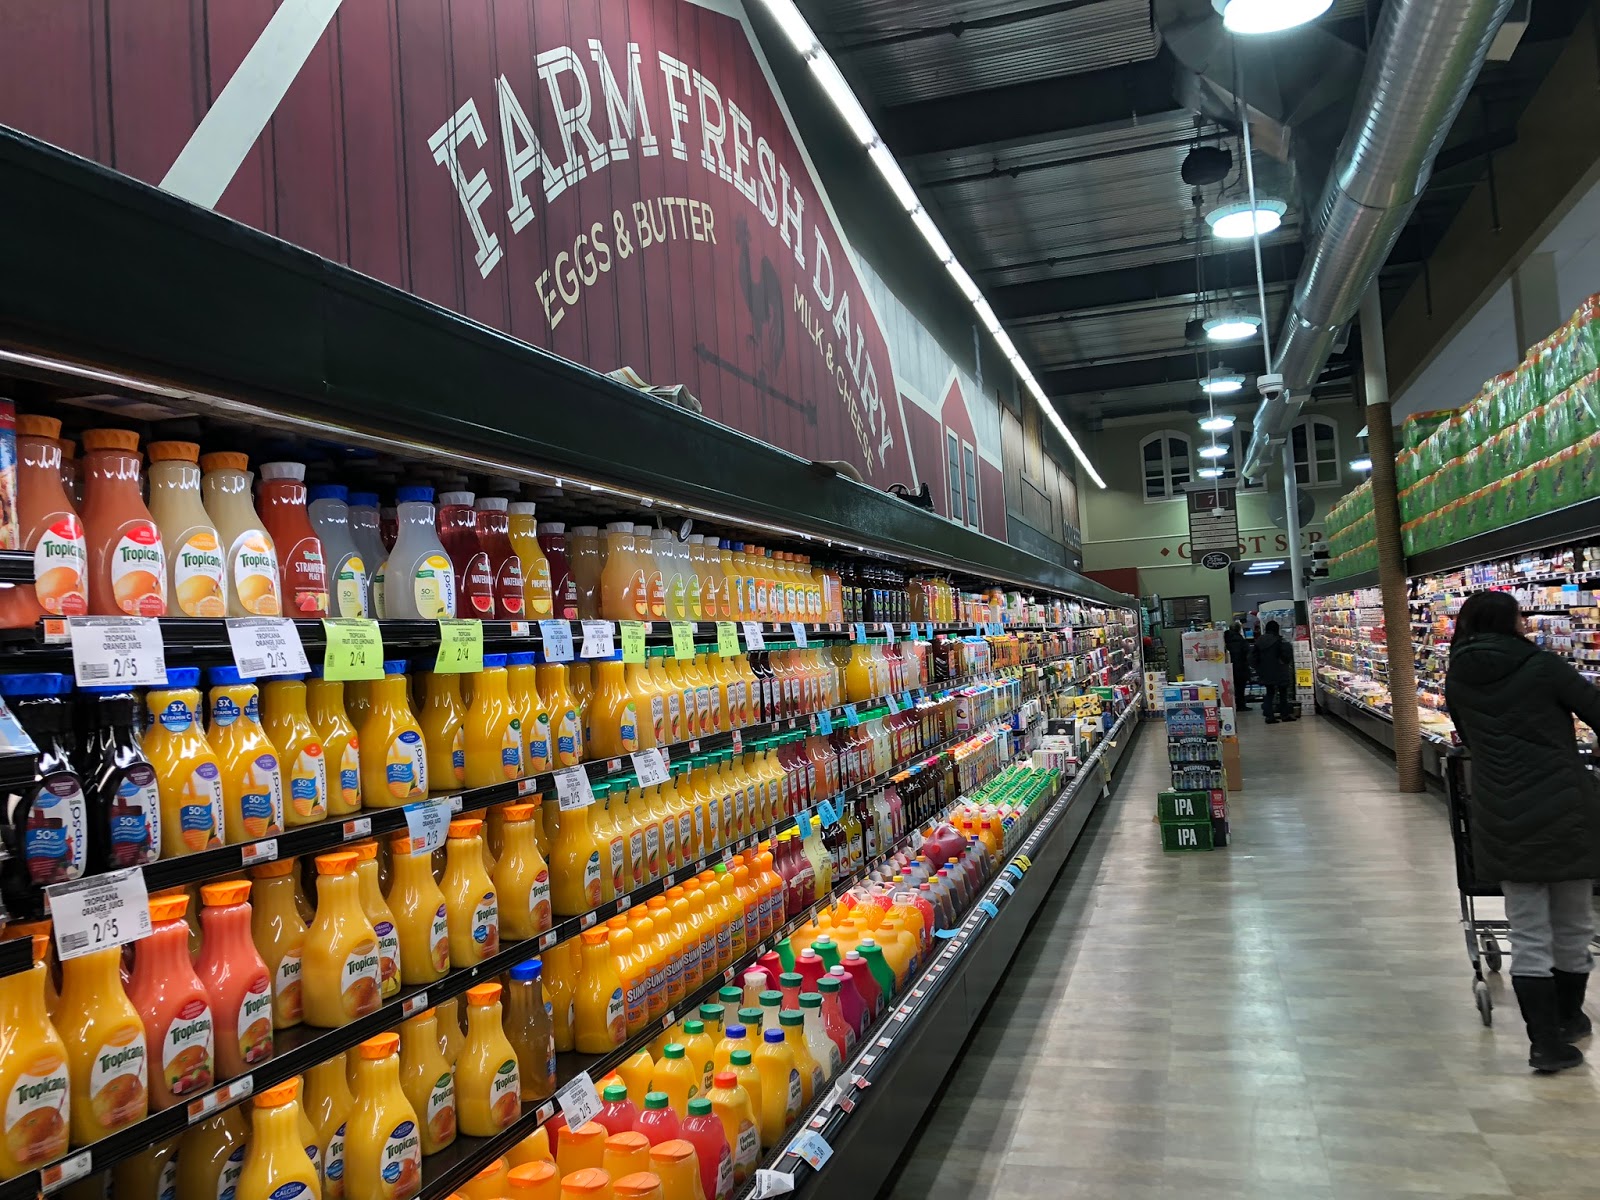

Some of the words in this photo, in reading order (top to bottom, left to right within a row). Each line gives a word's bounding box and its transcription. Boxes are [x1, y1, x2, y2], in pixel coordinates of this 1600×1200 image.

[427, 38, 660, 279] FARM
[658, 50, 806, 270] FRESH
[812, 225, 894, 468] DAIRY
[534, 222, 613, 330] EGGS
[612, 210, 634, 259] &
[631, 197, 717, 248] BUTTER
[794, 284, 824, 355] MILK
[825, 343, 834, 369] &
[836, 366, 875, 476] CHEESE
[1207, 495, 1215, 504] 7
[1178, 536, 1266, 559] GST
[444, 575, 453, 609] Trop50
[113, 658, 138, 677] 2/$5
[267, 651, 287, 669] 2/$5
[350, 651, 366, 667] 2/$4
[170, 704, 184, 712] 3X
[1205, 708, 1216, 716] 15
[415, 748, 424, 783] Trop50
[297, 779, 311, 787] 50%
[249, 795, 266, 804] 50%
[273, 777, 281, 820] Trop50
[1174, 799, 1194, 816] IPA
[188, 806, 206, 815] 50%
[423, 813, 439, 821] TROPICANA
[119, 817, 139, 826] 50%
[150, 795, 158, 853] Trop50
[35, 830, 59, 840] 50%
[73, 806, 81, 870] Trop50
[1178, 828, 1198, 846] IPA
[82, 904, 108, 916] ORANGE
[108, 899, 124, 910] JUICE
[84, 892, 119, 906] TROPICANA
[93, 918, 119, 943] 2/$5
[281, 959, 301, 977] Tropi
[170, 1019, 211, 1045] Tropicana
[99, 1046, 143, 1073] Tropicana
[16, 1077, 66, 1104] Tropicana
[386, 1136, 418, 1159] Tropicana
[274, 1186, 302, 1198] CALCIUM
